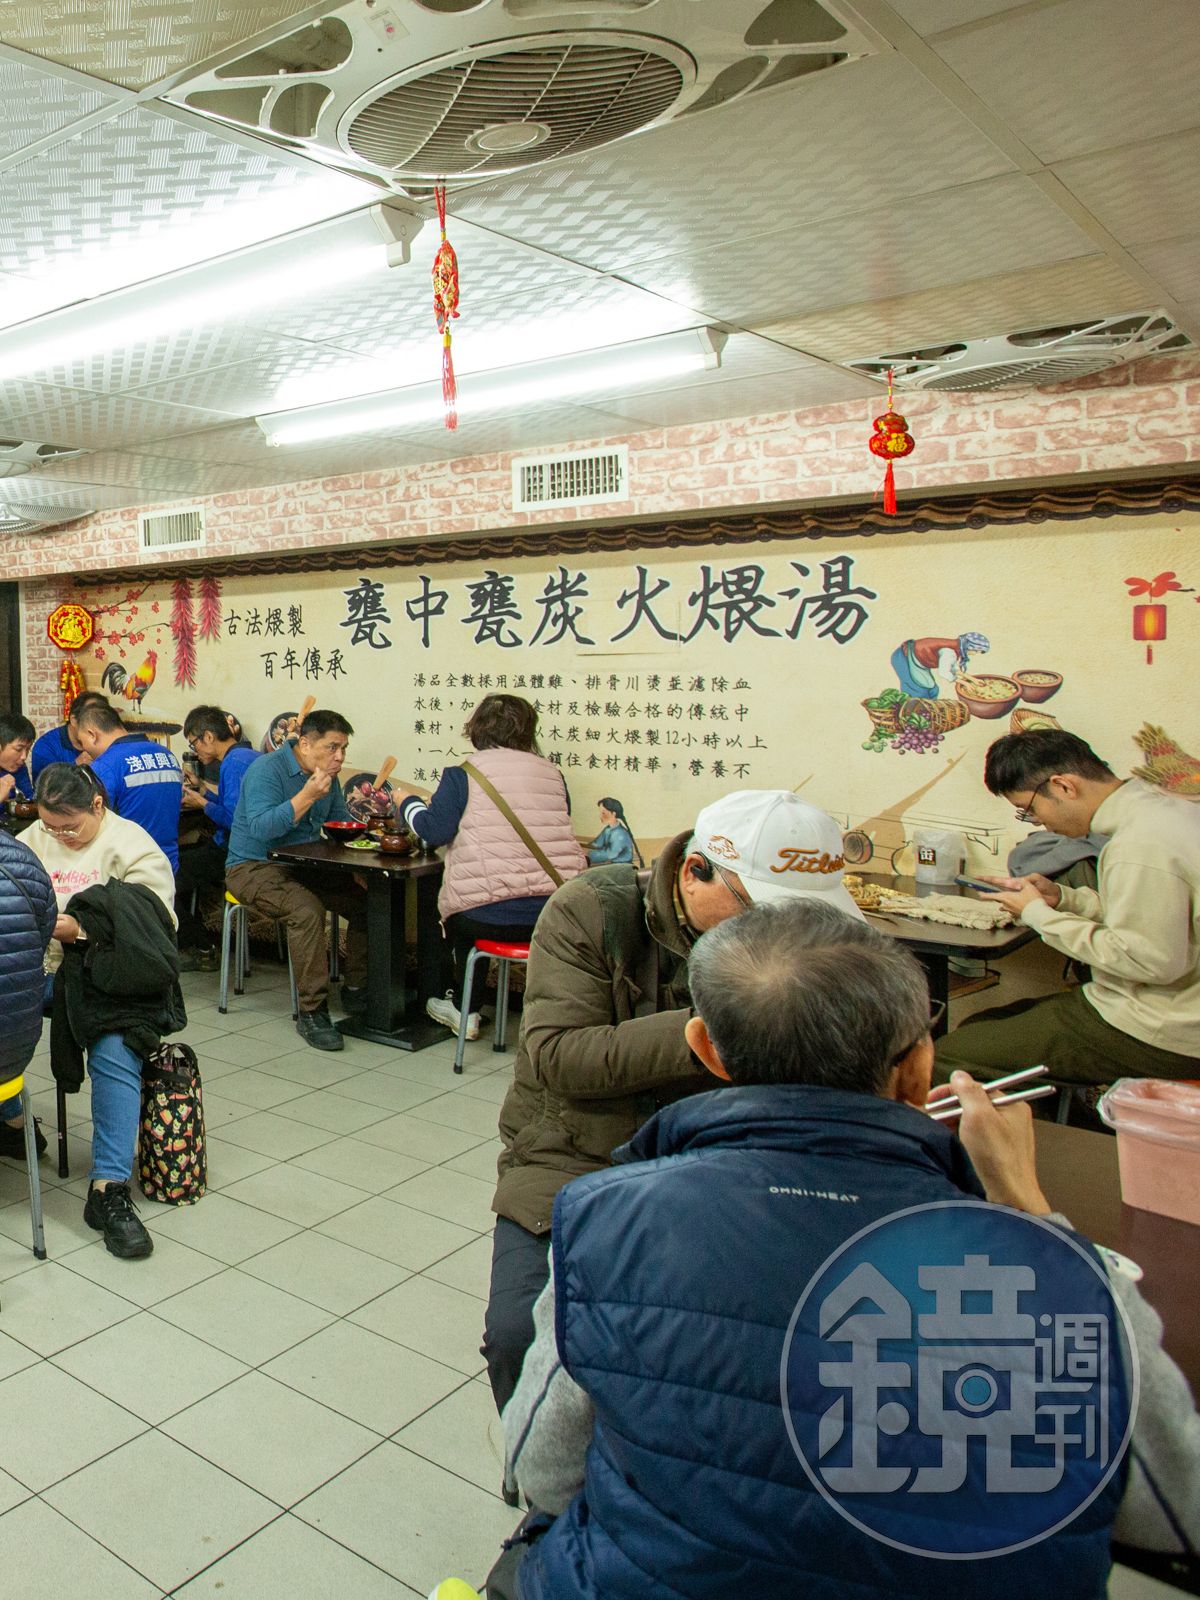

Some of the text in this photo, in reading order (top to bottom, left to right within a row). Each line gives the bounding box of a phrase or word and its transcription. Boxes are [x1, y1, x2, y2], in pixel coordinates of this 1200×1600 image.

[340, 556, 877, 649] 甕中甕炭火煨湯
[223, 604, 305, 638] 古法煨製
[260, 647, 347, 681] 百年傳承
